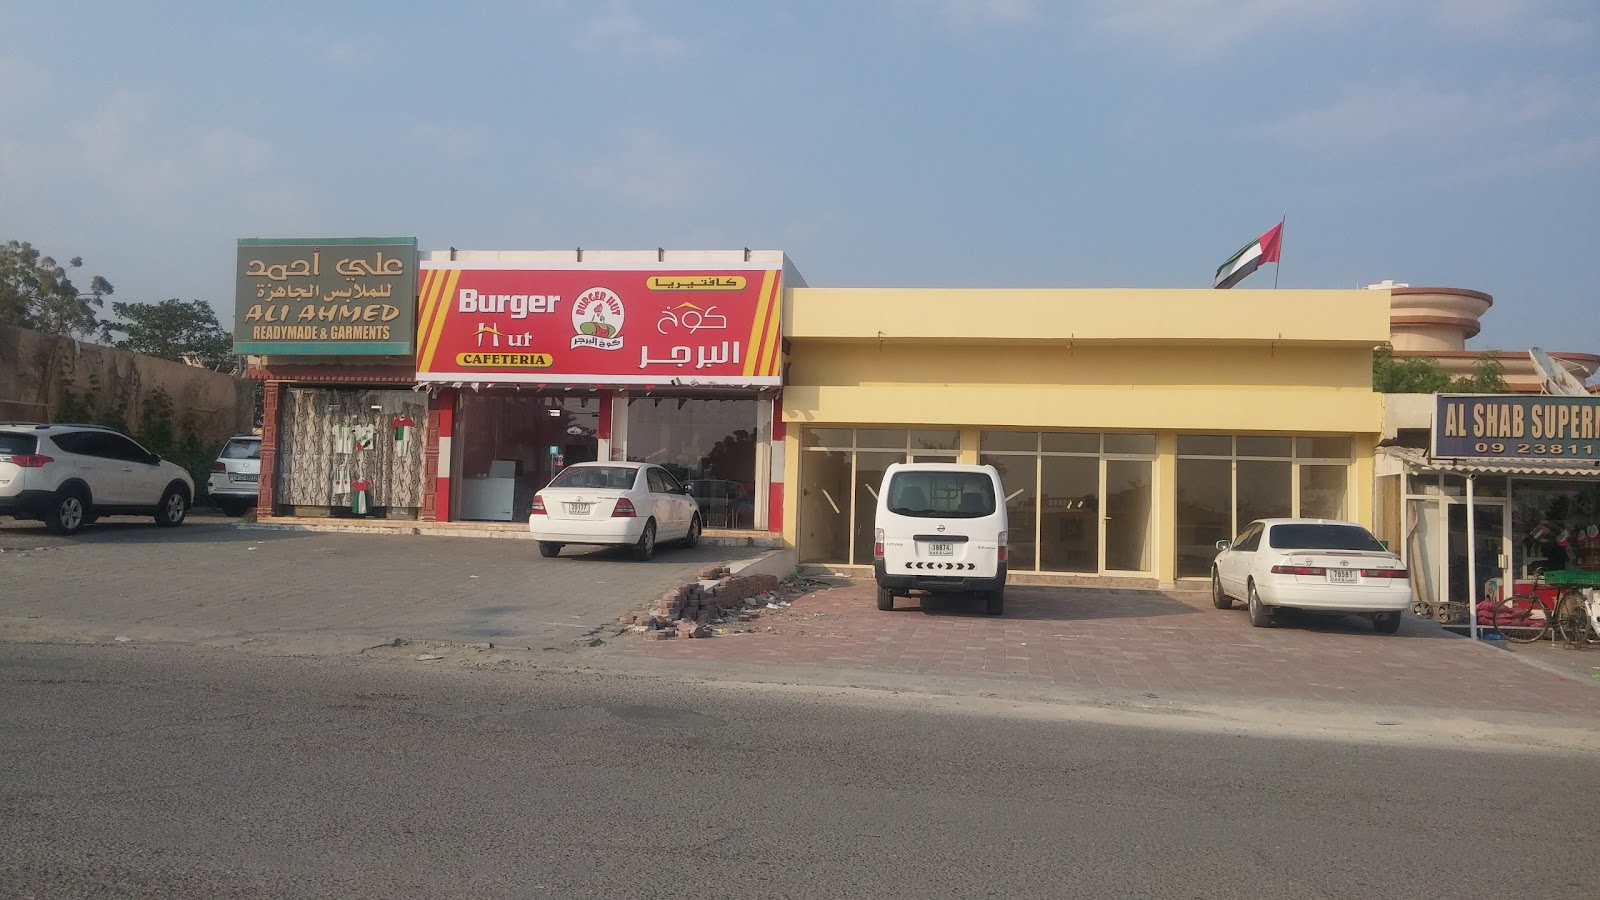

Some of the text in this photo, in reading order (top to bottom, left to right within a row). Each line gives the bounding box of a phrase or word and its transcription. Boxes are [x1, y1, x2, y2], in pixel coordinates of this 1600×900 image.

[246, 247, 403, 281] علي أحمد
[256, 283, 392, 302] للملابس الجاهزة
[655, 278, 737, 288] كافتيريا
[245, 304, 400, 323] ALI AHMED
[459, 289, 561, 319] Burger
[575, 291, 621, 316] BURGER HUT
[657, 305, 727, 334] كوخ
[253, 325, 391, 341] READYMADE & GARMENTS
[463, 354, 546, 365] CAFETERIA
[638, 341, 740, 369] البرجر
[1445, 403, 1467, 437] AL
[1473, 403, 1525, 438] SHAB
[1474, 442, 1505, 453] 09
